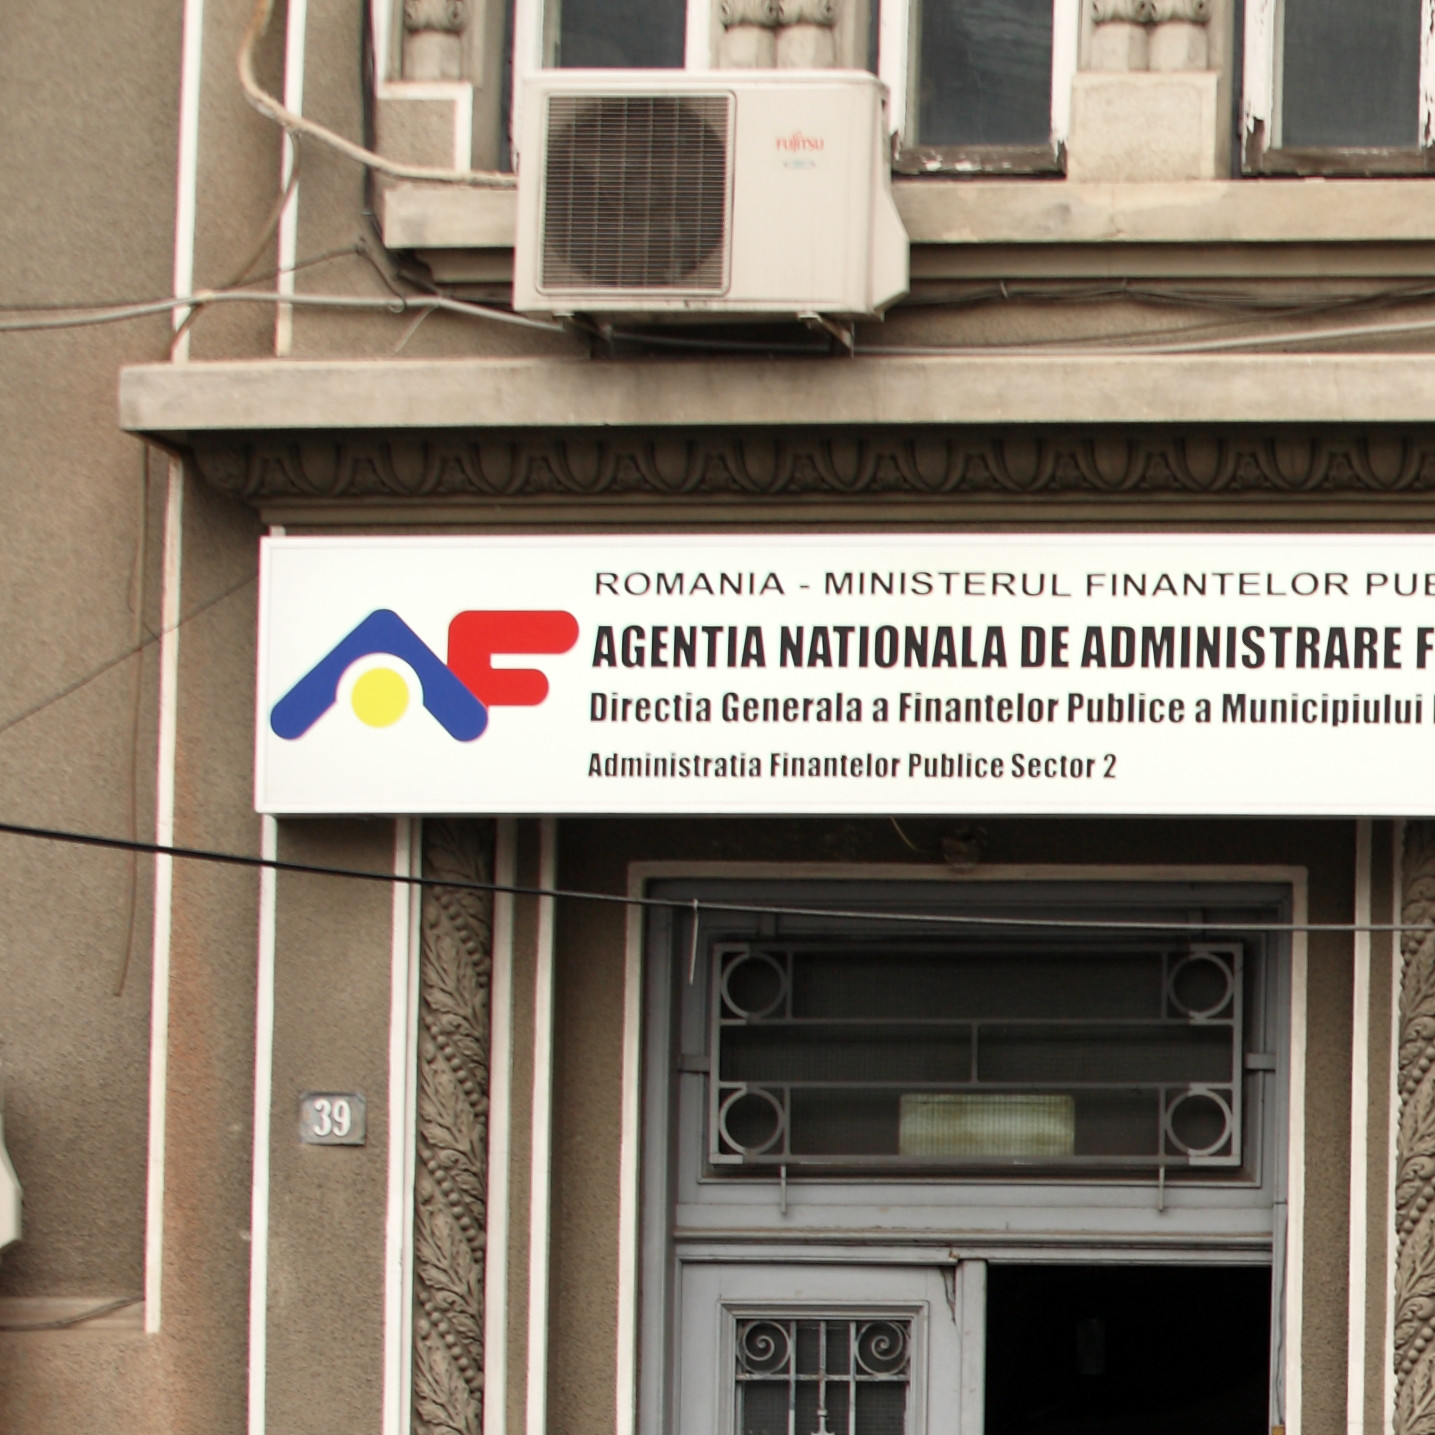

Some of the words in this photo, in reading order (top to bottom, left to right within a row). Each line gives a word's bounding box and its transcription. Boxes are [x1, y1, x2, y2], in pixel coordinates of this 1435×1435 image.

[776, 131, 825, 154] FUJITSU
[595, 572, 785, 595] ROMANIA
[825, 572, 1071, 595] MINISTERUL
[1086, 572, 1348, 596] FINANTELOR
[592, 624, 766, 668] AGENTIA
[779, 624, 1007, 668] NATIONALA
[1020, 625, 1069, 668] DE
[1080, 625, 1402, 669] ADMINISTRARE
[590, 692, 711, 722] Directia
[722, 692, 862, 722] Generala
[872, 697, 888, 722] a
[899, 692, 1059, 723] Finantelor
[1067, 692, 1185, 723] Publice
[1195, 698, 1211, 723] a
[1222, 693, 1422, 727] Municipiului
[588, 752, 761, 778] Administratia
[770, 752, 900, 778] Finantelor
[908, 752, 1004, 778] Publice
[1011, 752, 1096, 778] Sector
[1103, 753, 1117, 778] 2
[312, 1098, 352, 1137] 39
